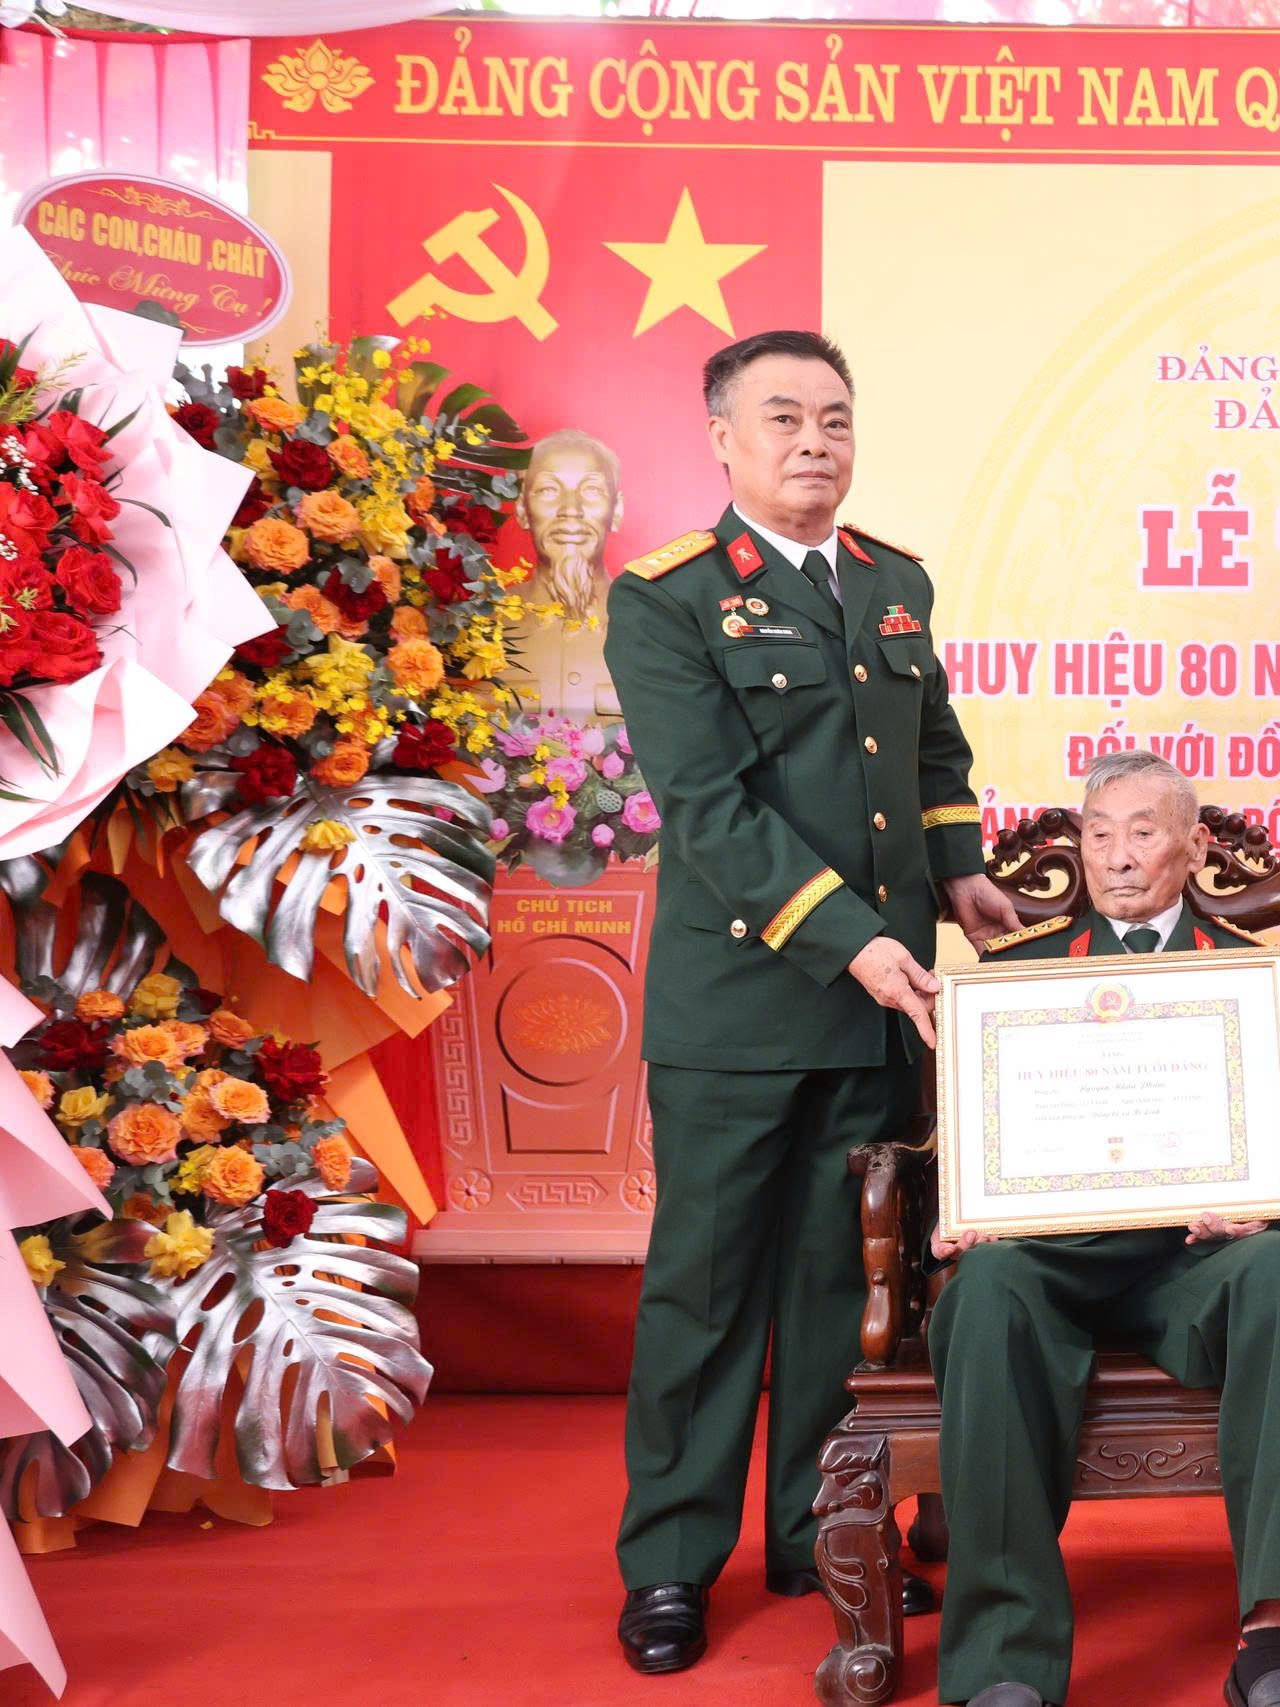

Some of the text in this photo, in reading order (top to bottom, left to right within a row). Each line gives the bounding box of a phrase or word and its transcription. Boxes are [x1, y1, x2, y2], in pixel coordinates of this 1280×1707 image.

[393, 26, 575, 119] ĐẢNG
[590, 38, 762, 136] CỘNG
[775, 33, 898, 124] SẢN
[917, 45, 1062, 141] VIỆT
[1076, 67, 1219, 127] NAM
[37, 199, 86, 242] CÁC
[1157, 345, 1280, 382] ĐẢNG
[1140, 473, 1250, 588] LỄ
[945, 642, 1038, 695] HUY
[1054, 632, 1163, 707] HIỆU
[1181, 644, 1237, 695] 80
[516, 894, 614, 915] CHỦ TỊCH
[532, 919, 568, 933] CHÍ
[575, 920, 632, 935] MINH
